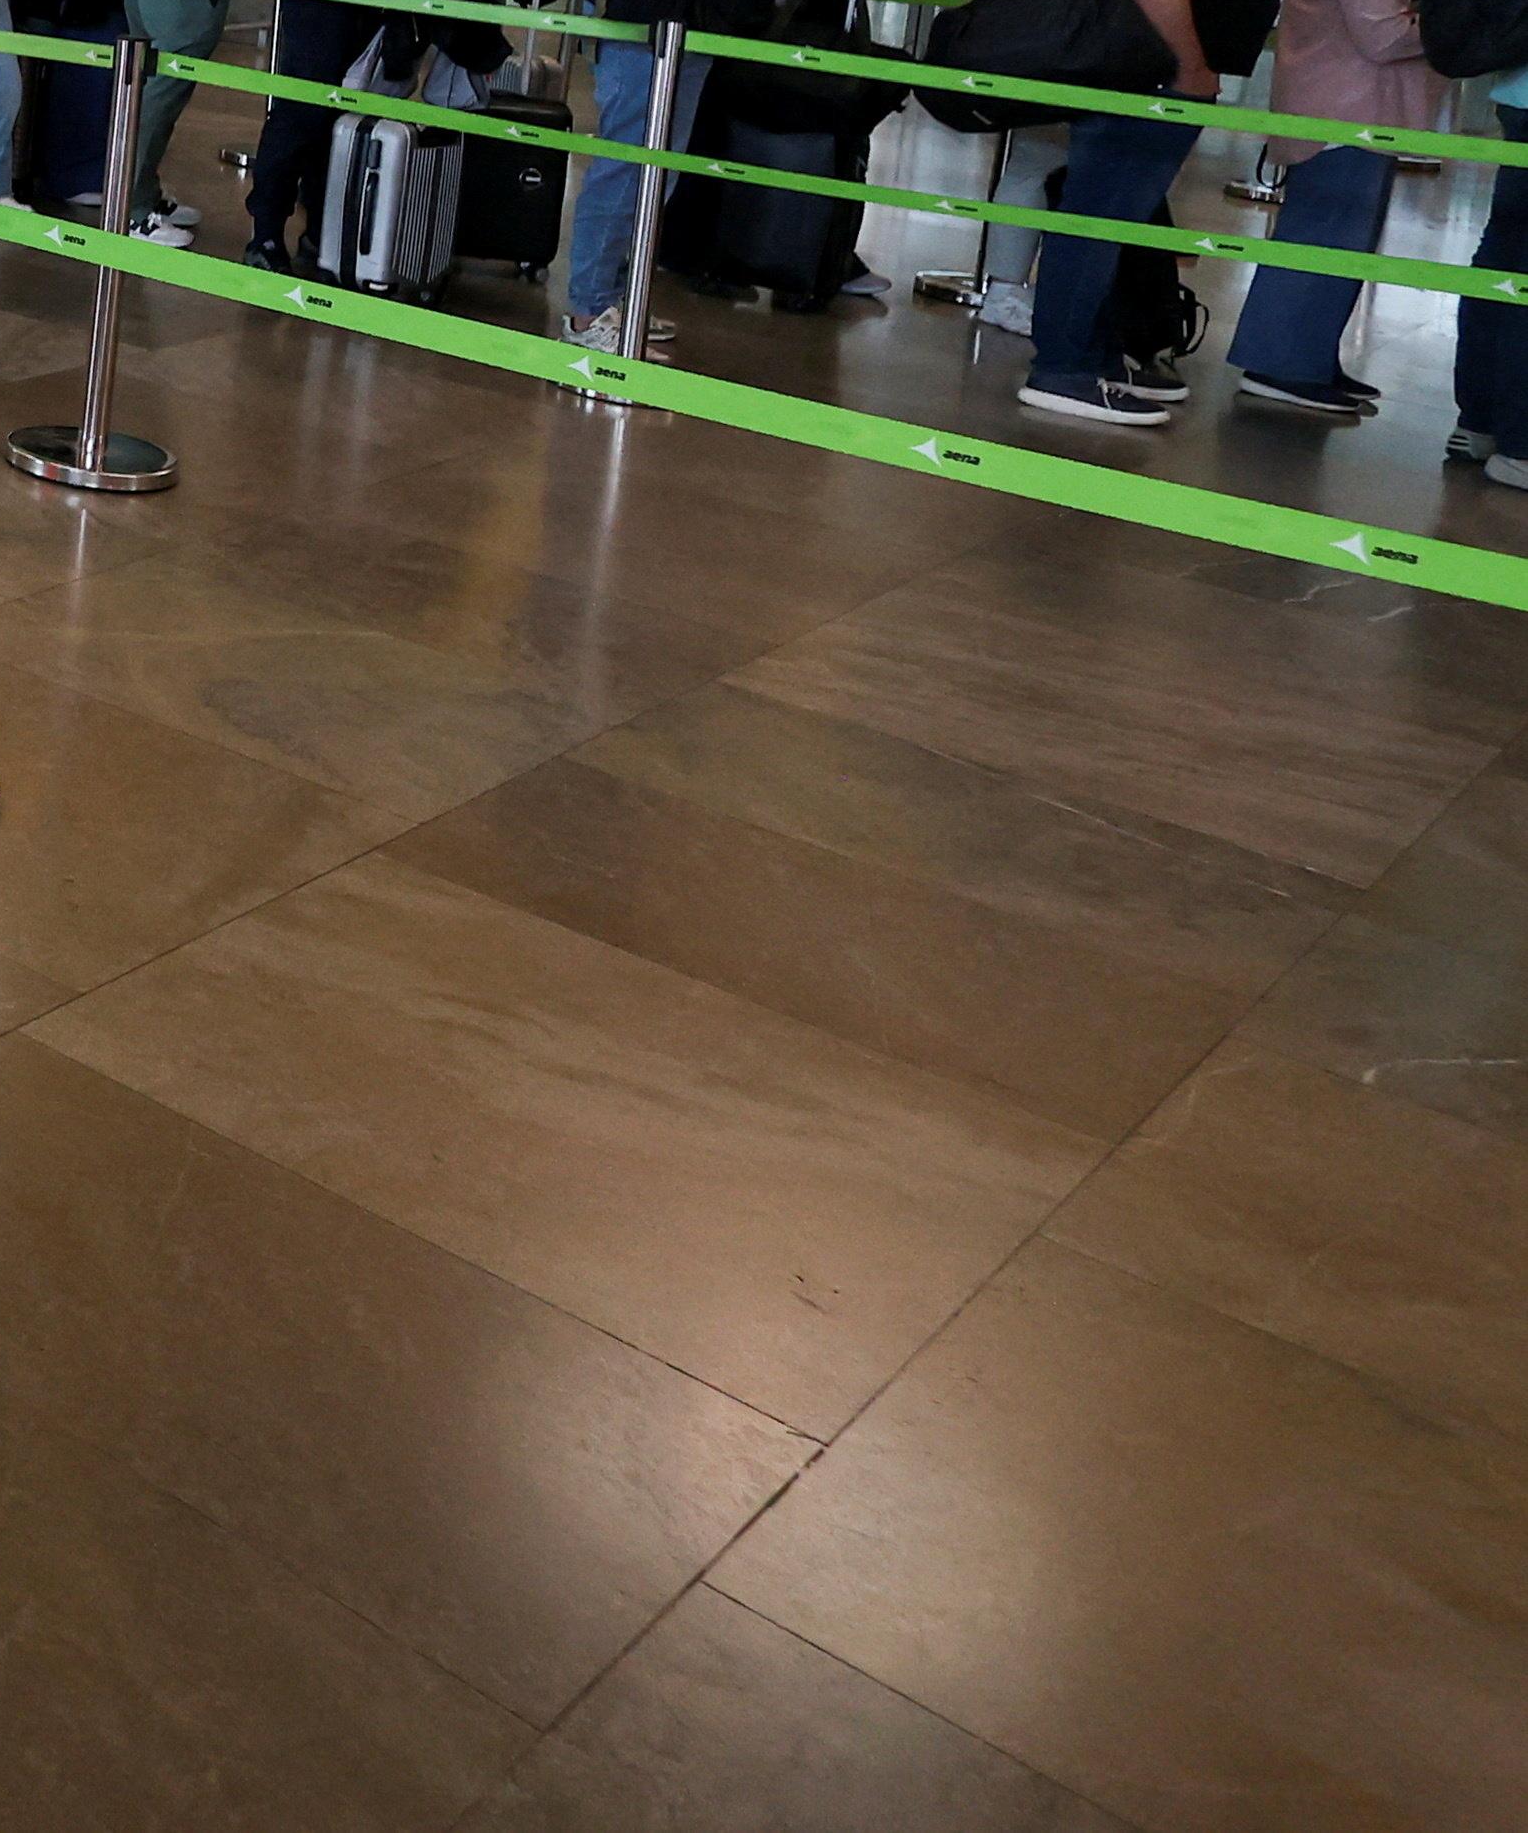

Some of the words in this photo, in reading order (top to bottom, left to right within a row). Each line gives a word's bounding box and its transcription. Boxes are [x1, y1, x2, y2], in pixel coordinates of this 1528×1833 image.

[63, 234, 86, 246] aena
[305, 295, 333, 309] aena
[594, 366, 627, 382] aena
[942, 450, 981, 466] aena
